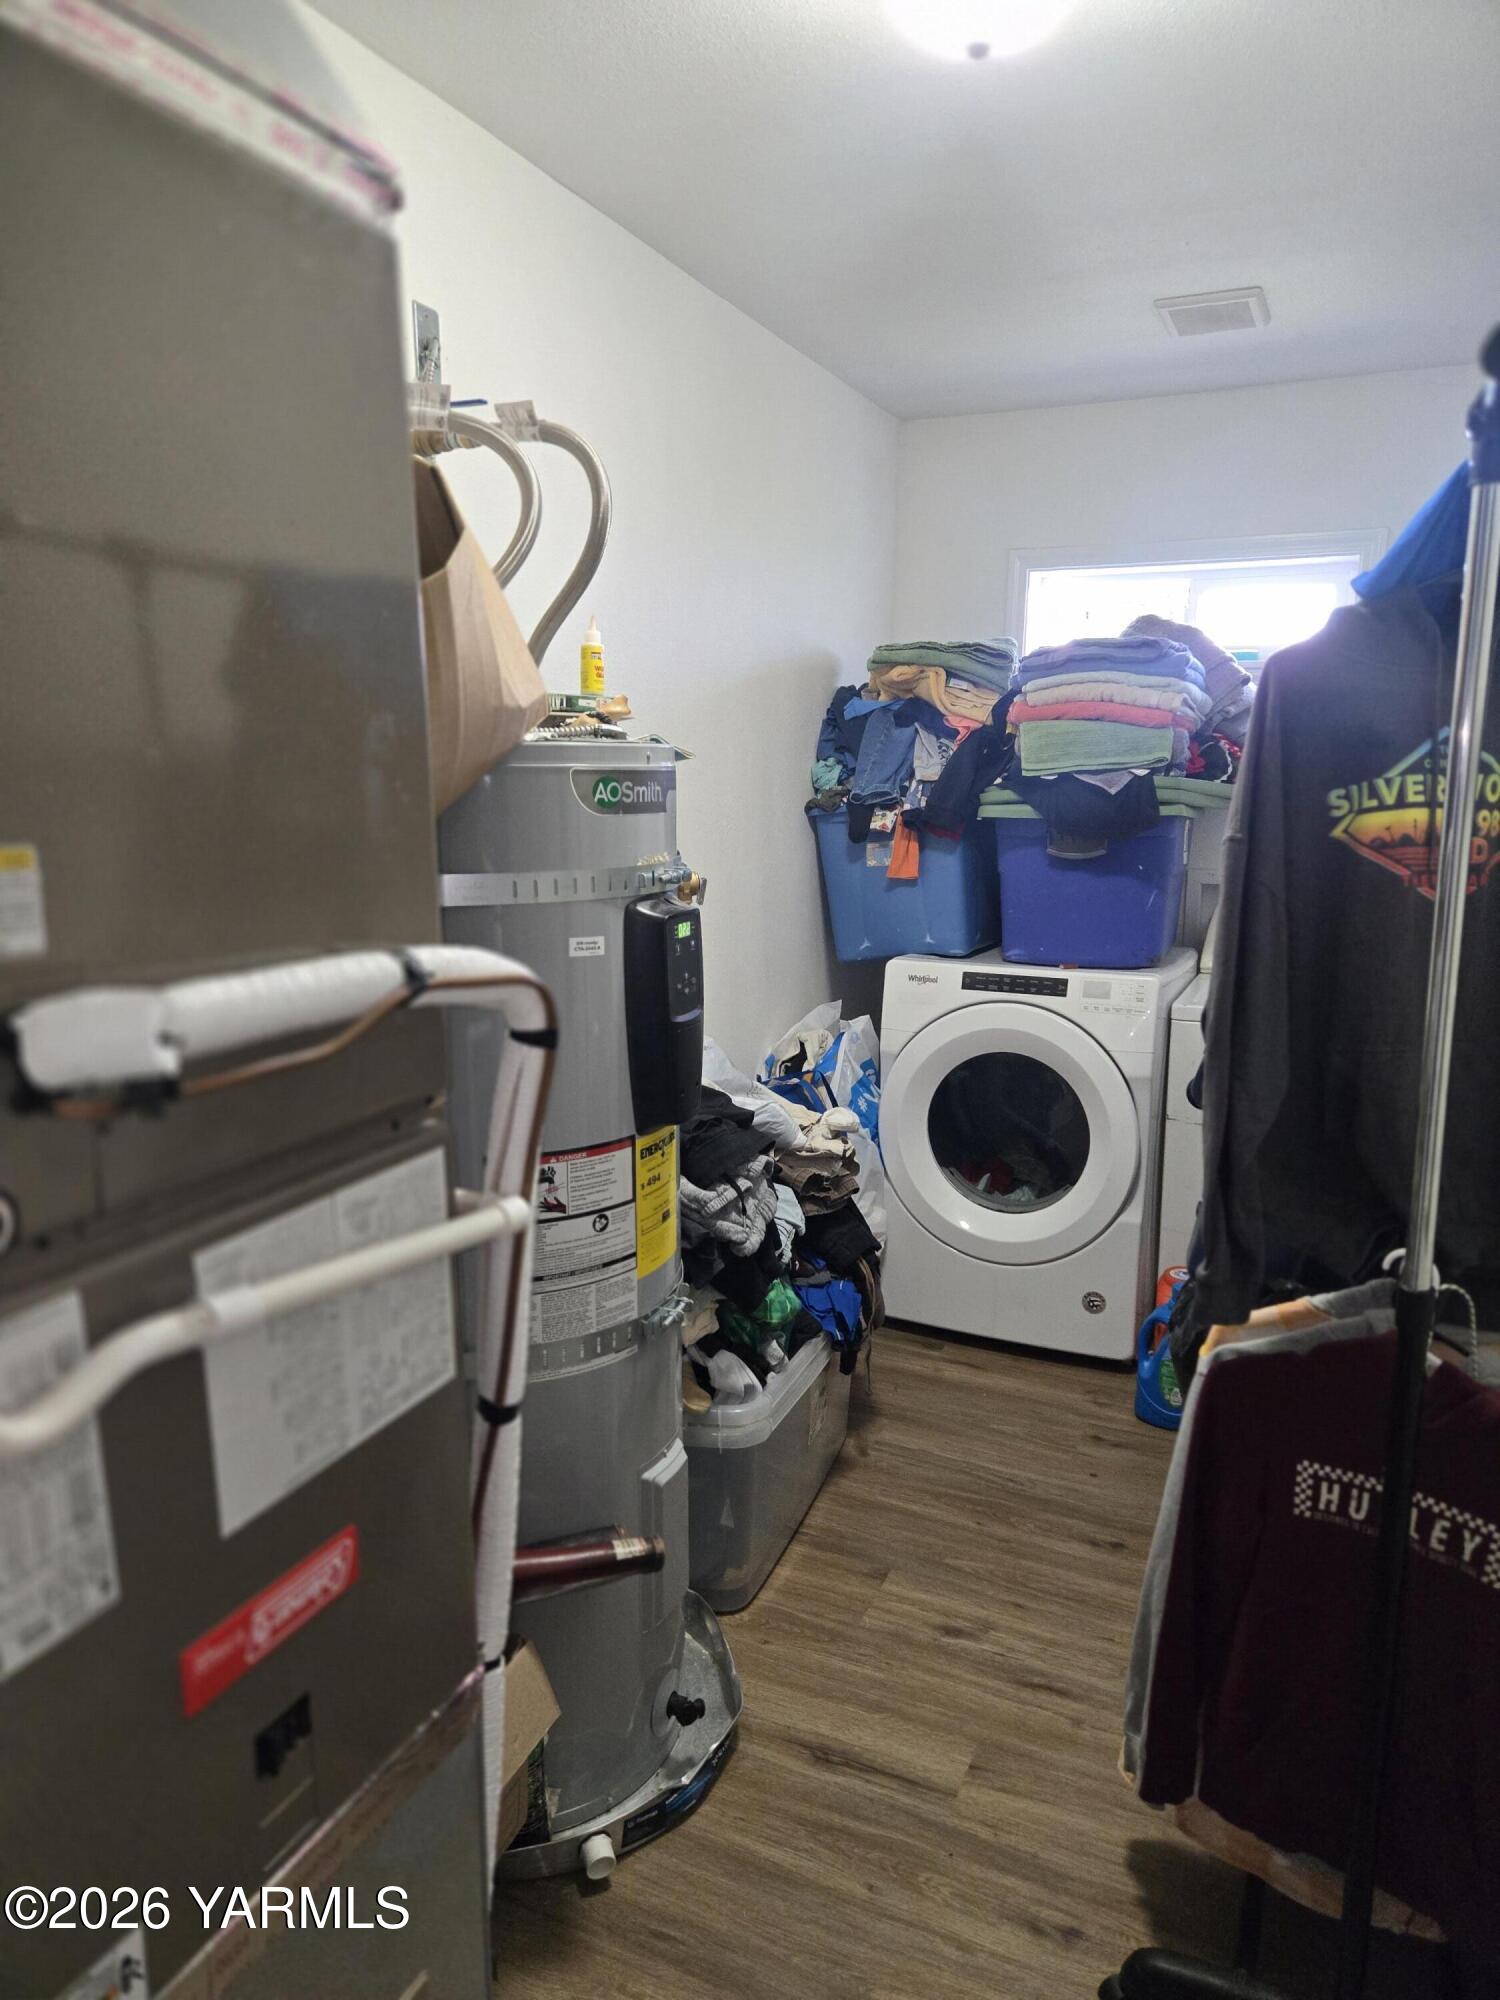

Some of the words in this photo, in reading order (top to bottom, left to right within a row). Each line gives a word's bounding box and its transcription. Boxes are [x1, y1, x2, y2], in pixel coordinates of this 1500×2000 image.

[908, 974, 938, 985] Whirlpool
[558, 1152, 587, 1162] DANGER
[1318, 1481, 1482, 1562] HULEY
